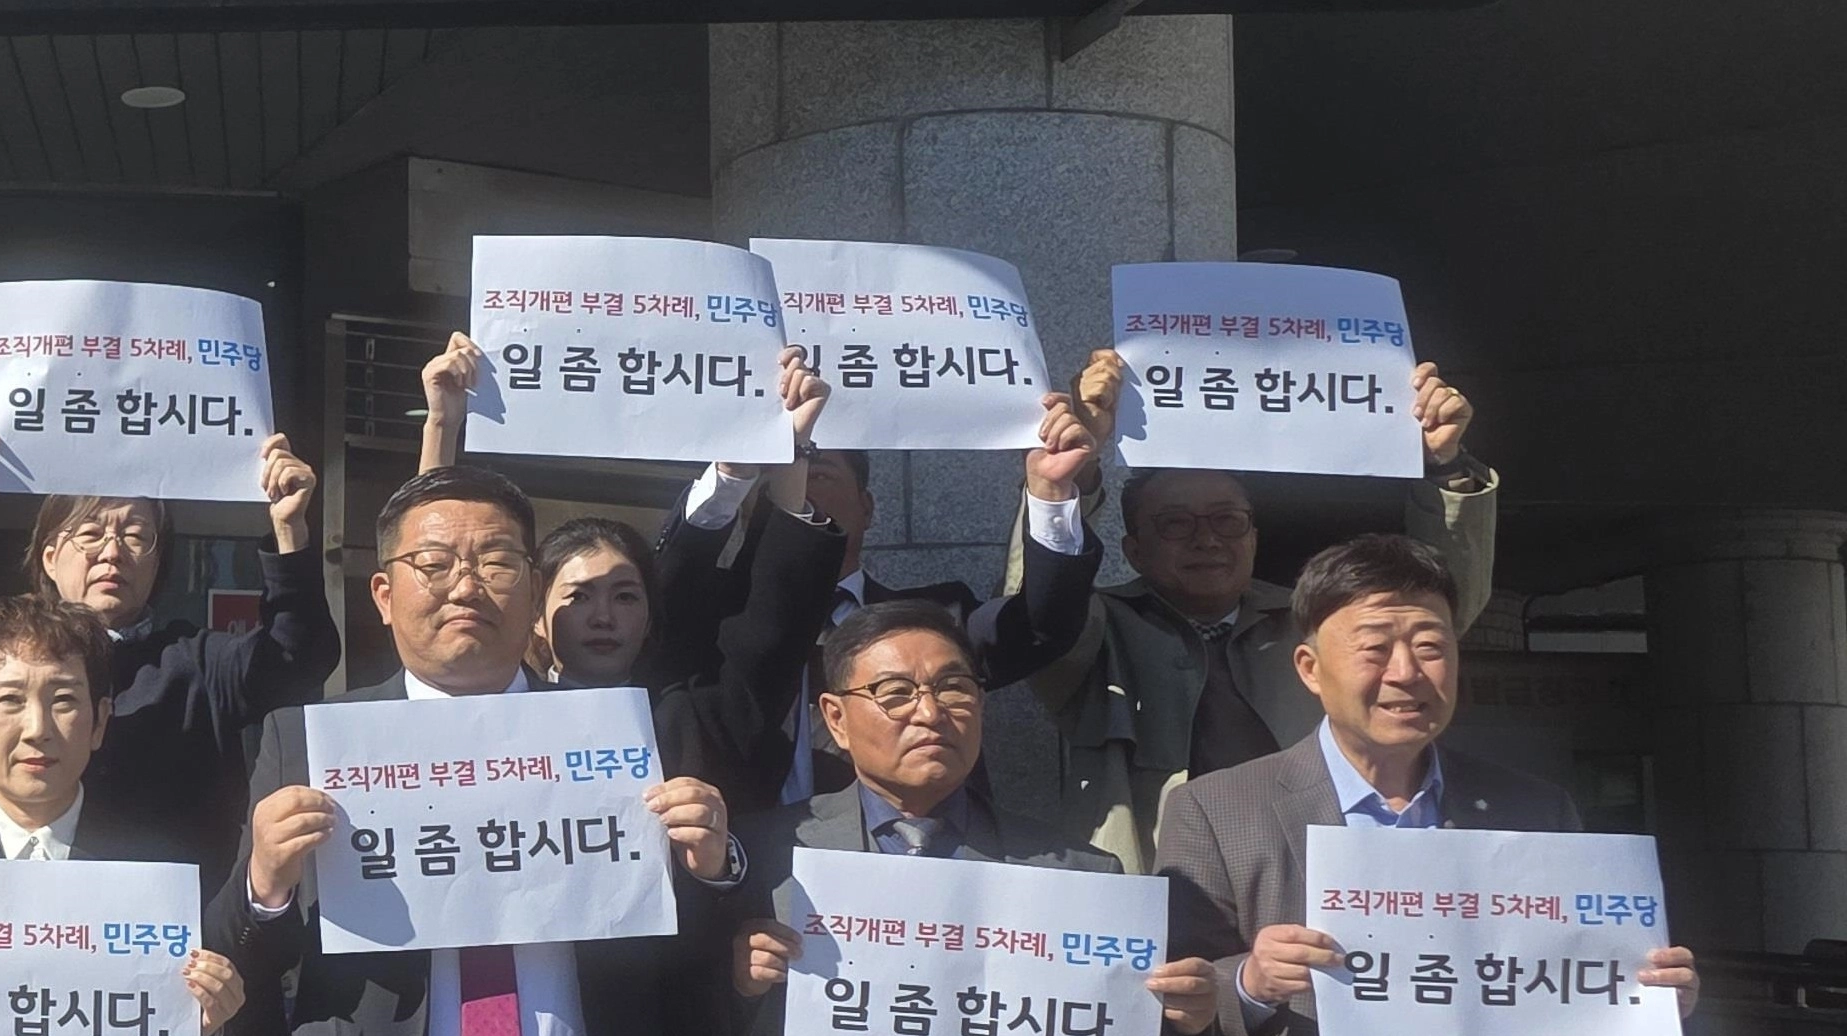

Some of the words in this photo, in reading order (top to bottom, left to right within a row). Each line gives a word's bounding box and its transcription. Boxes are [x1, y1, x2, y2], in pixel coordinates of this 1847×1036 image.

[483, 290, 572, 314] 조직개편
[580, 292, 623, 316] 부결
[633, 294, 700, 321] 5차례,
[707, 294, 777, 328] 민주당
[780, 292, 846, 315] 직개편
[852, 294, 893, 315] 부결
[901, 295, 964, 318] 5차례,
[967, 295, 1028, 327] 민주당
[1125, 314, 1211, 336] 조직개편
[1220, 316, 1259, 338] 부결
[1269, 318, 1331, 342] 5차례,
[1338, 319, 1403, 346] 민주당
[81, 336, 121, 360] 부결
[130, 338, 192, 364] 5차례,
[198, 339, 262, 371] 민주당
[503, 345, 541, 389] 일
[560, 347, 600, 391] 좀
[618, 348, 763, 396] 합시다.
[838, 345, 877, 387] 좀
[894, 344, 1031, 387] 합시다.
[11, 389, 45, 431] 일
[62, 390, 100, 433] 좀
[117, 389, 252, 435] 합시다.
[1147, 366, 1183, 407] 일
[1200, 368, 1238, 409] 좀
[1255, 369, 1393, 413] 합시다.
[323, 763, 421, 792] 조직개편
[429, 760, 477, 787] 부결
[486, 756, 560, 782] 5차례,
[566, 745, 652, 781] 민주당
[351, 828, 396, 879] 일
[415, 825, 460, 876] 좀
[478, 816, 640, 872] 합시다.
[1321, 890, 1423, 917] 조직개편
[1433, 893, 1479, 919] 부결
[1491, 894, 1568, 923] 5차례,
[1576, 894, 1657, 927] 민주당
[23, 923, 96, 954] 5차례,
[104, 923, 191, 957] 민주당
[804, 914, 905, 946] 조직개편
[915, 922, 964, 951] 부결
[975, 927, 1054, 961] 5차례,
[1063, 933, 1157, 971] 민주당
[1343, 951, 1389, 1001] 일
[1411, 955, 1457, 1004] 좀
[1476, 954, 1640, 1005] 합시다.
[826, 978, 869, 1030] 일
[891, 984, 937, 1036] 좀
